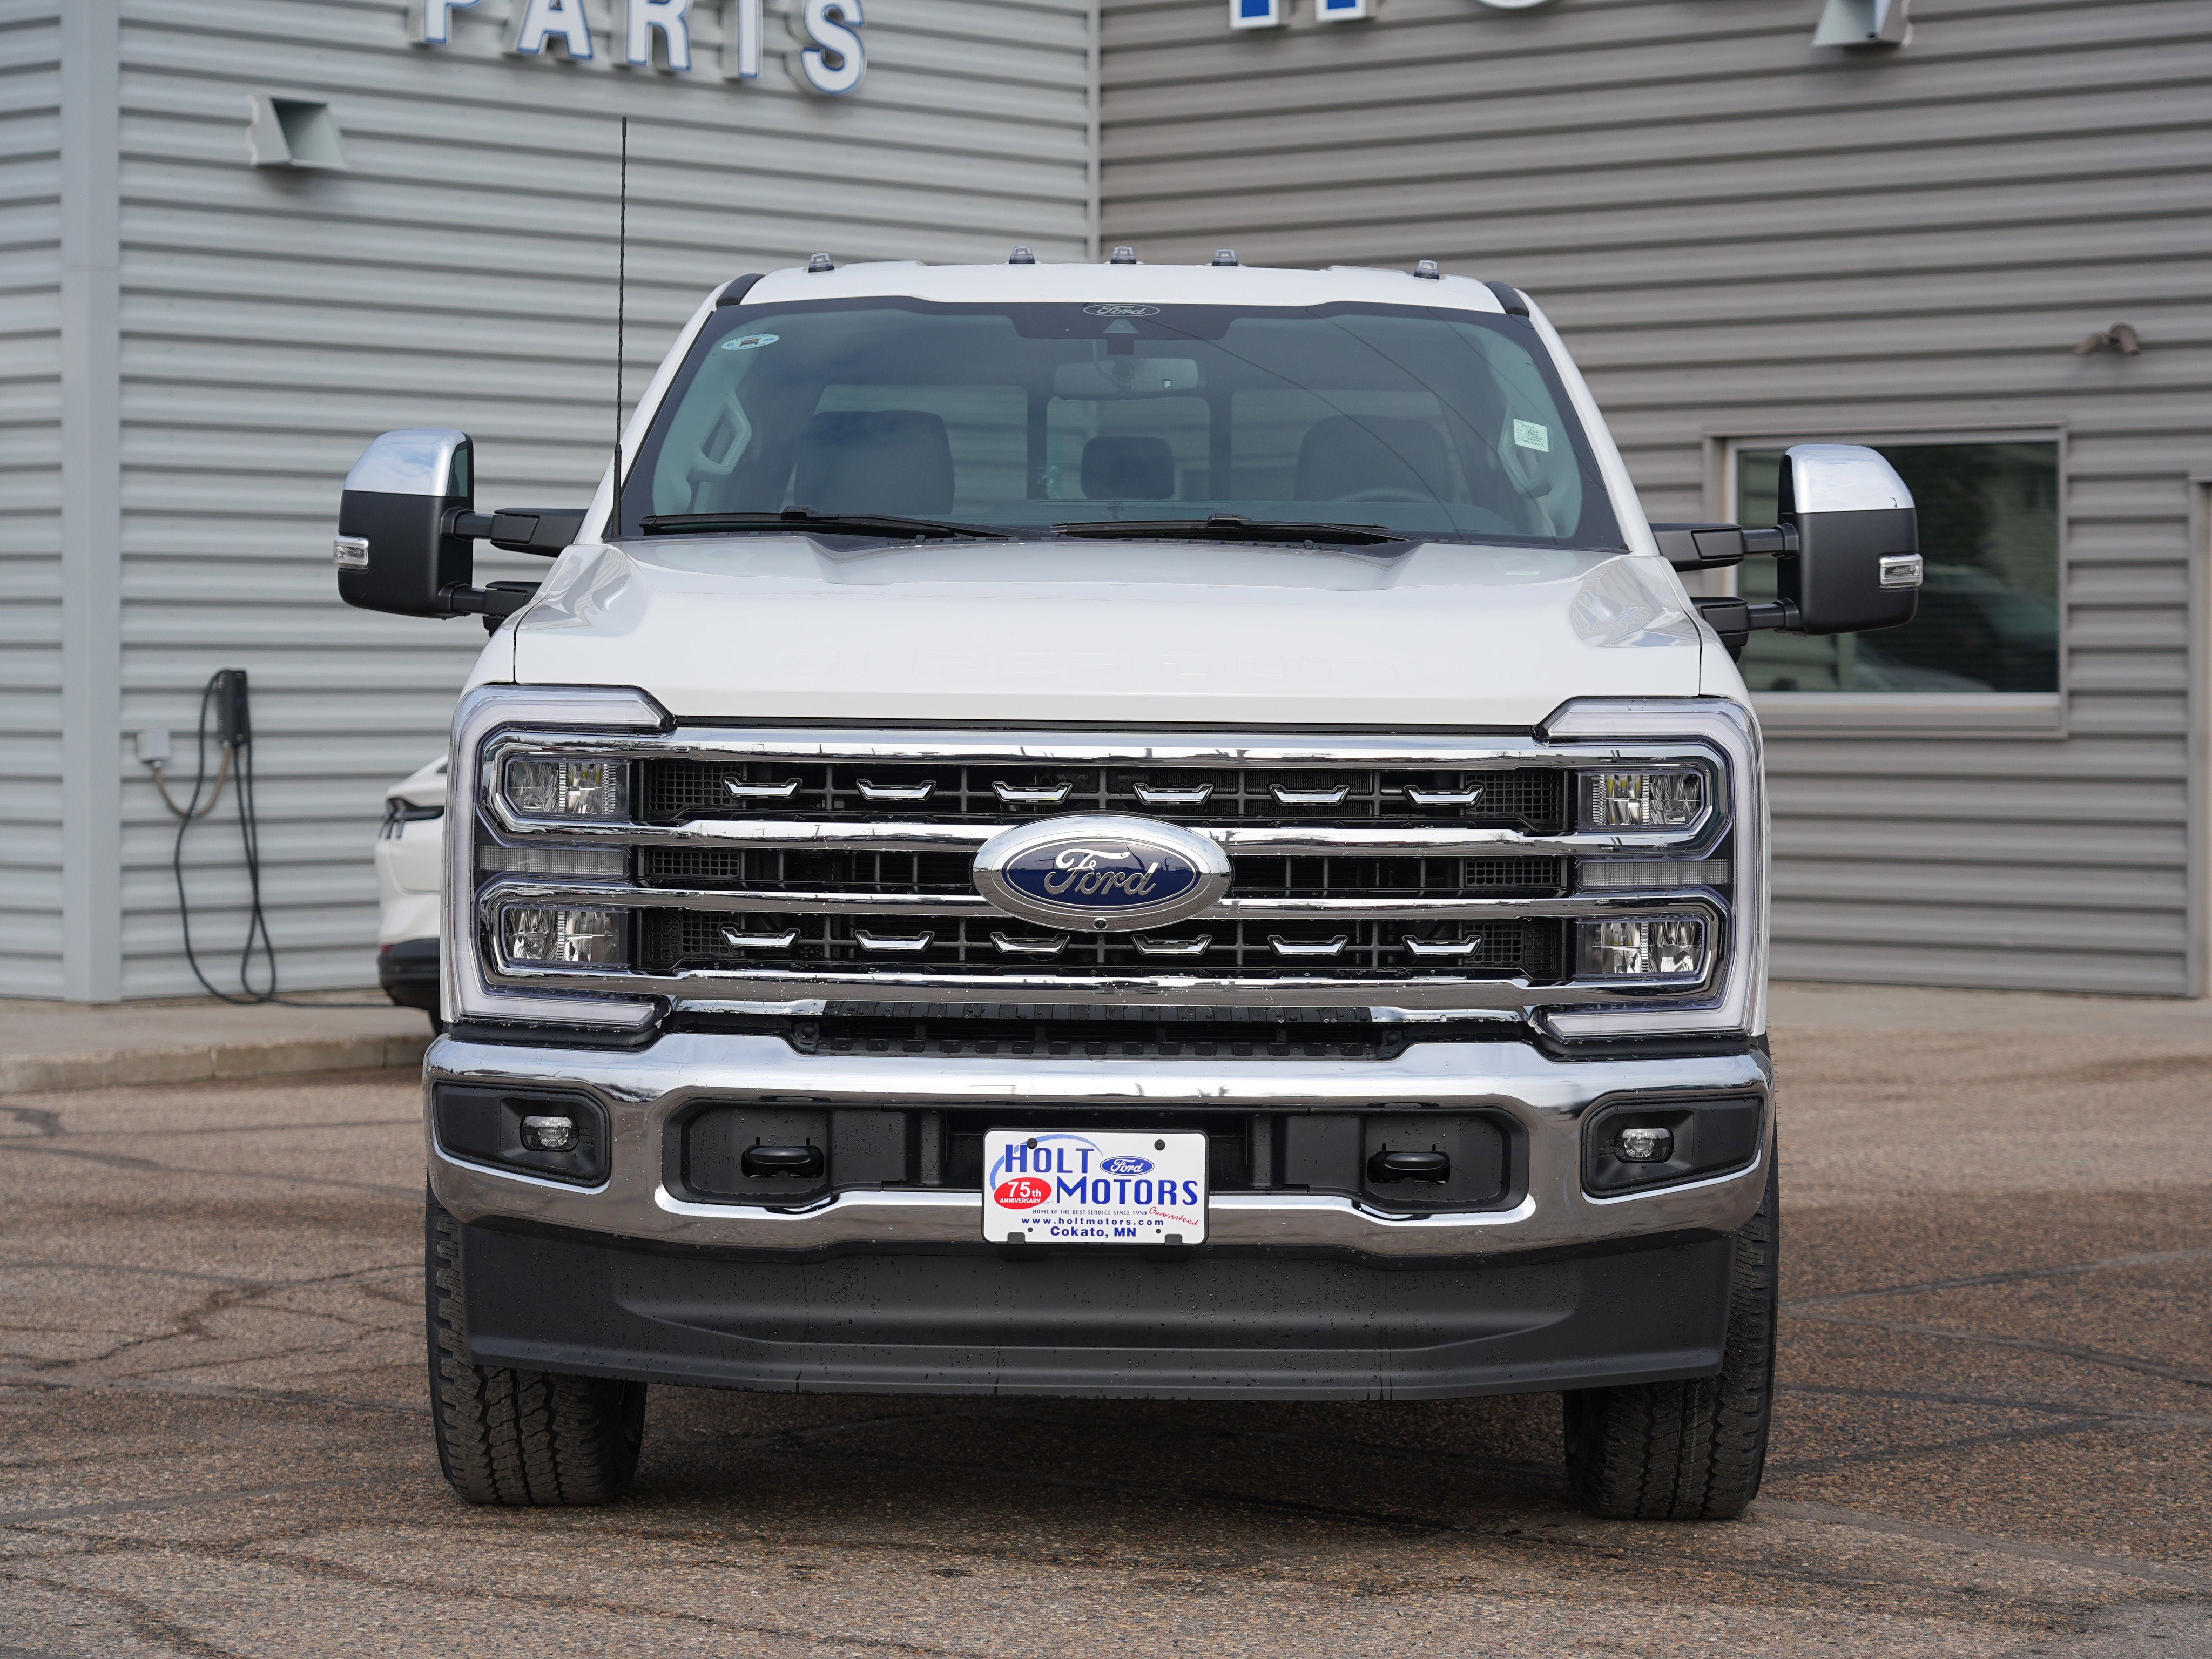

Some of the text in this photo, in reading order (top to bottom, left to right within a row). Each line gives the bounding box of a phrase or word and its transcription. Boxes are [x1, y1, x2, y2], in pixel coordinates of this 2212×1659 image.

[1096, 305, 1147, 315] Ford
[778, 650, 1435, 682] SUPER DUTY
[1044, 848, 1159, 895] Ford
[1005, 1144, 1095, 1173] HOLT
[1110, 1158, 1143, 1173] Ford
[1008, 1181, 1042, 1198] 75th
[1056, 1175, 1198, 1205] MOTORS
[1021, 1217, 1164, 1225] www.holtmotors.com
[1149, 1206, 1199, 1226] Guaranteed
[1050, 1226, 1137, 1238] Cokato, MN
